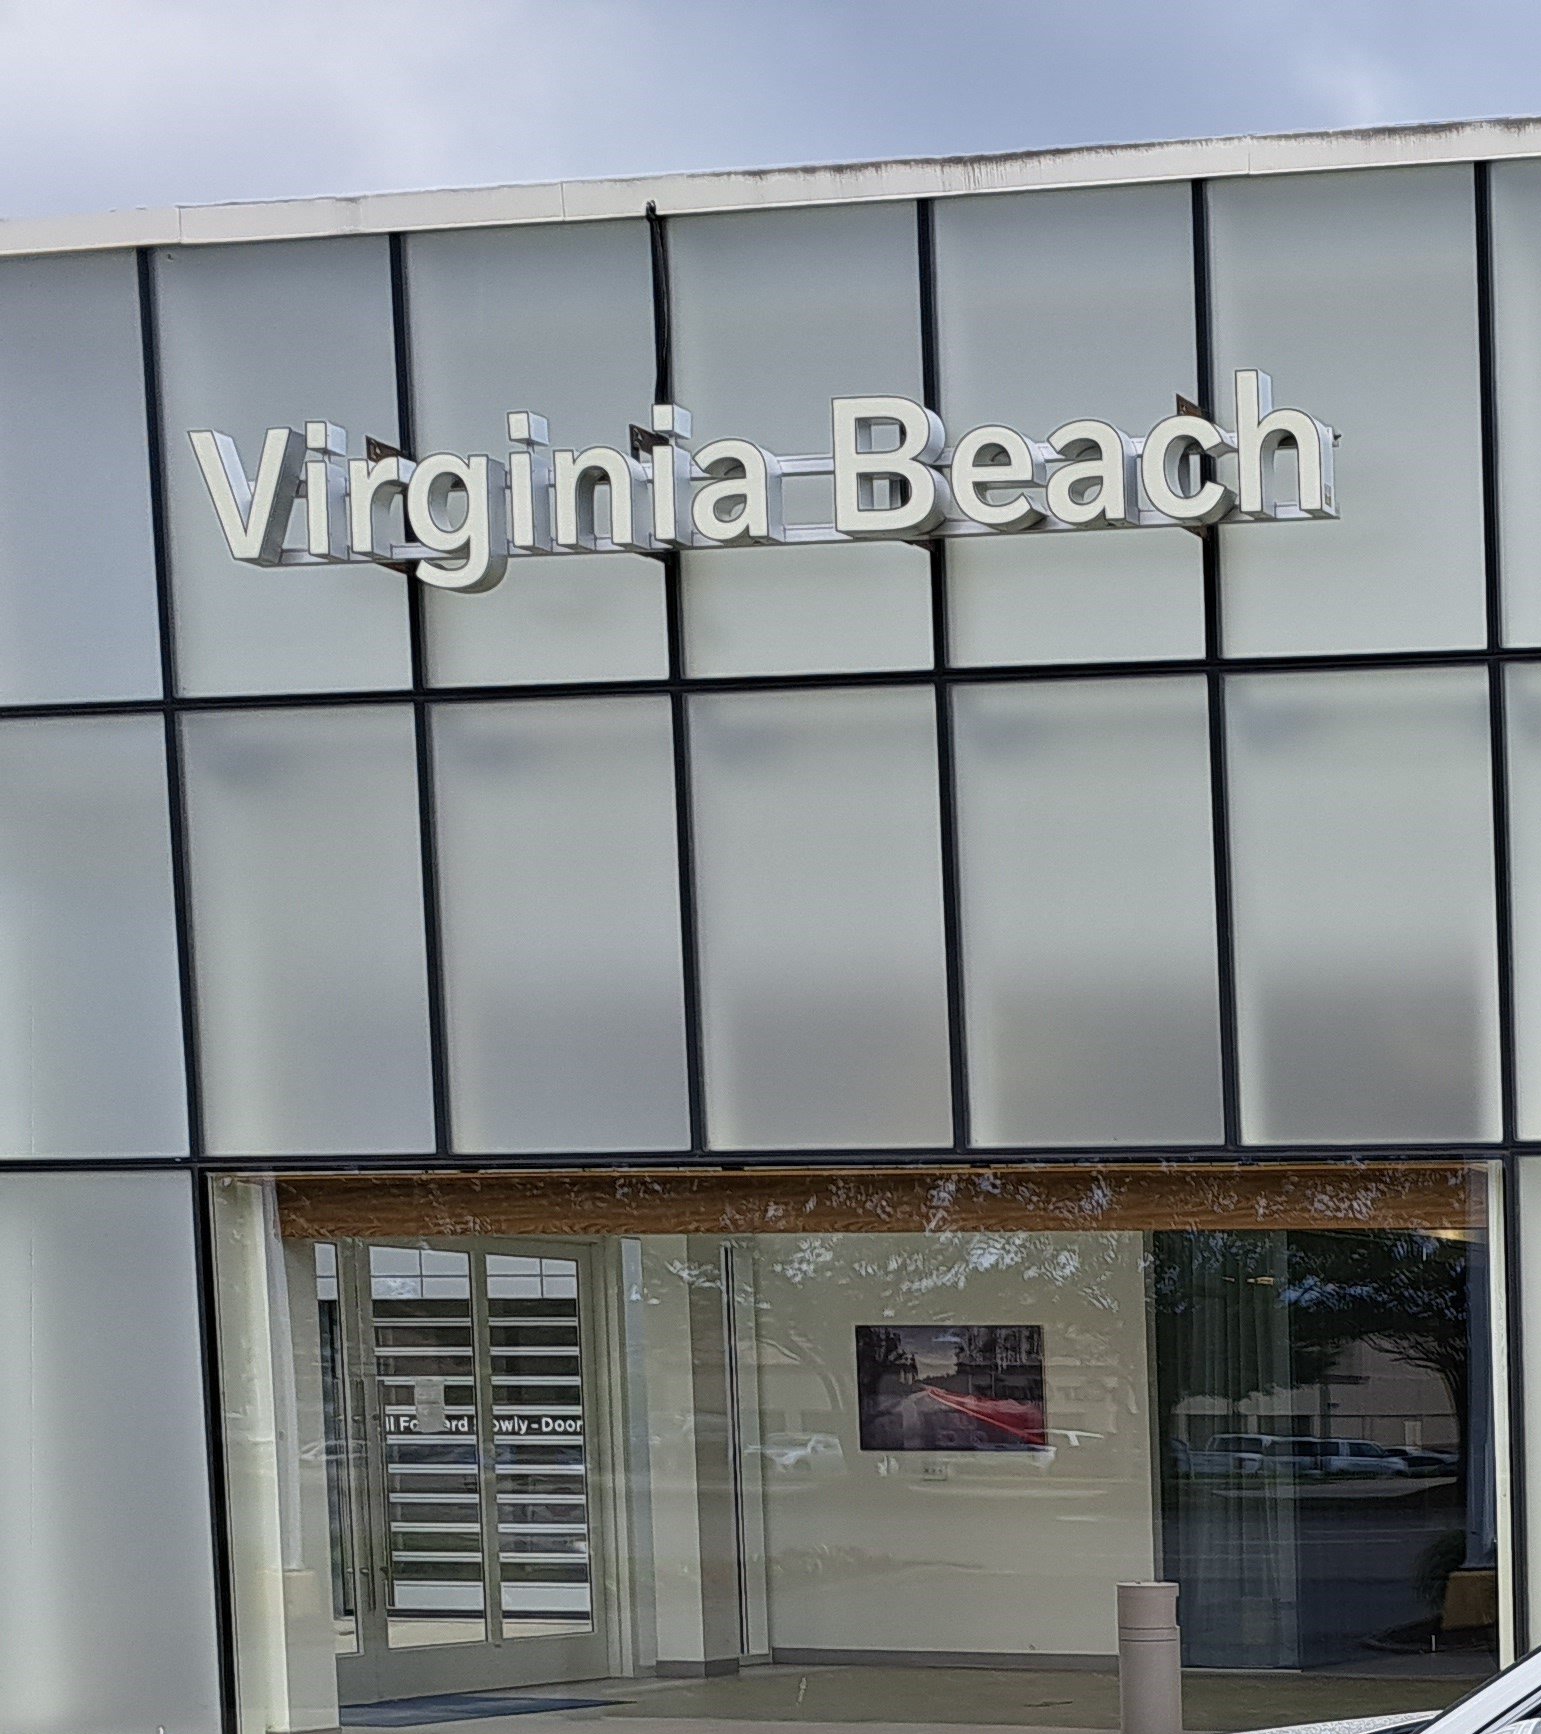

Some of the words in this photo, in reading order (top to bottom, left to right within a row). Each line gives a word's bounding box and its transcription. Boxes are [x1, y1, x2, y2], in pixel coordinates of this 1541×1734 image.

[187, 402, 783, 593] Virginia
[831, 369, 1338, 540] Beach
[400, 1416, 469, 1432] Foard
